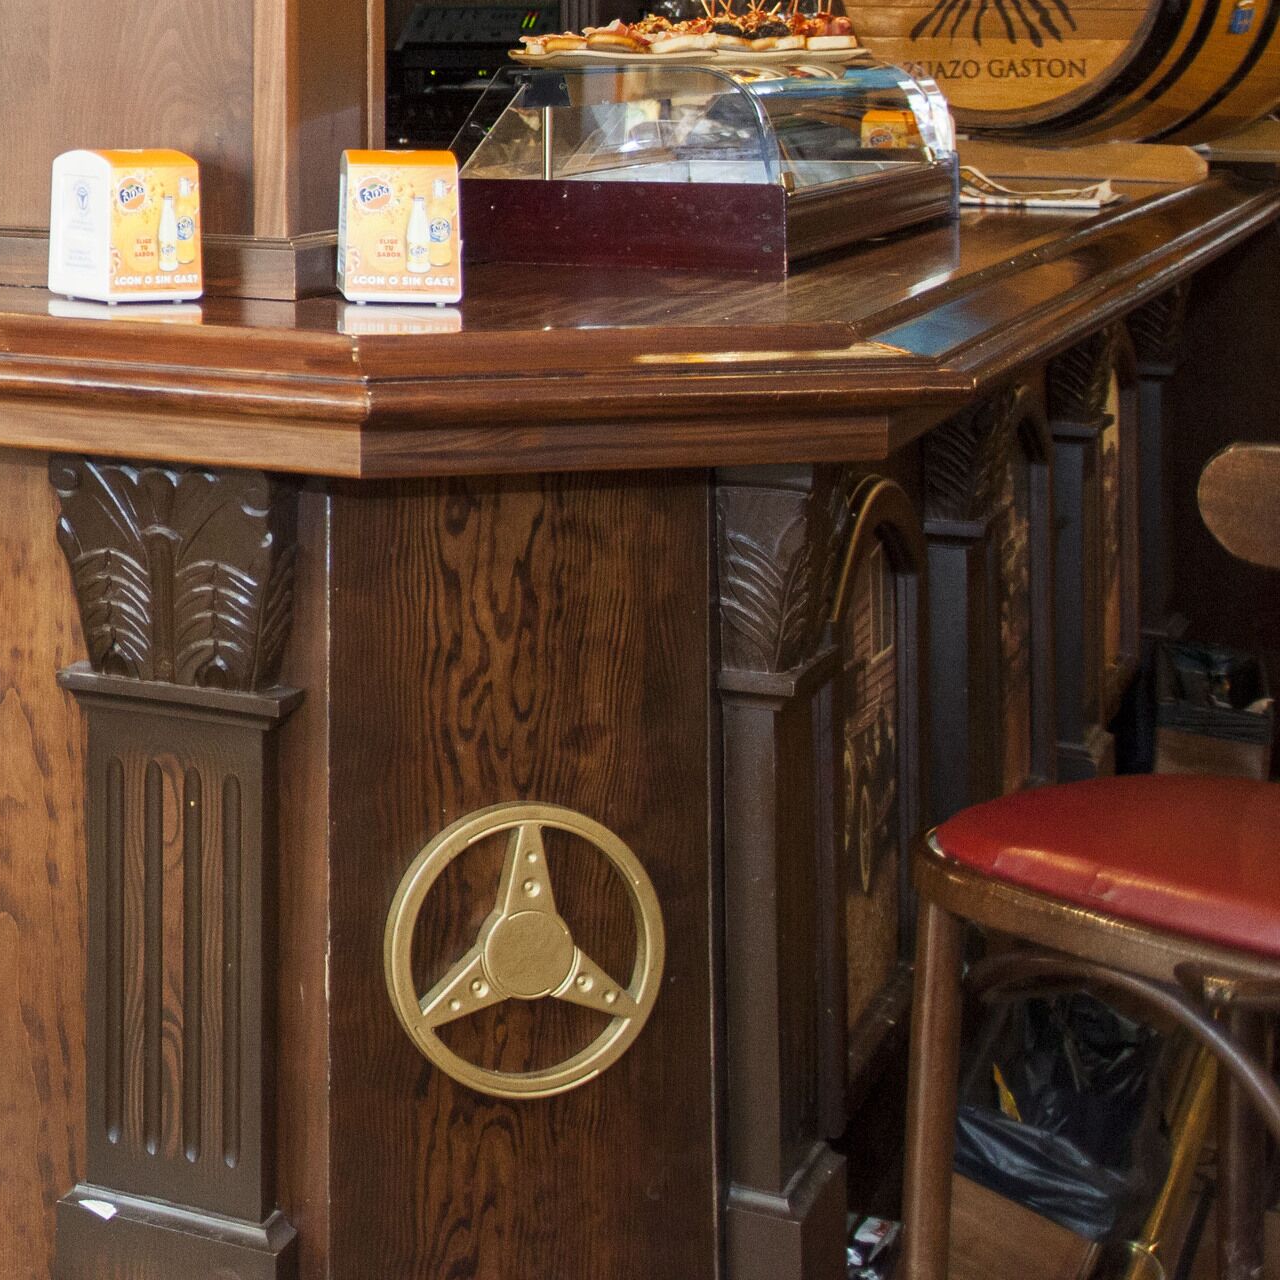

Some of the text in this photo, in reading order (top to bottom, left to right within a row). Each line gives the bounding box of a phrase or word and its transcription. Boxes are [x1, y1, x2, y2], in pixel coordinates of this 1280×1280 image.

[986, 58, 1088, 79] GASTON
[144, 276, 153, 285] O
[155, 275, 172, 285] SIN
[388, 276, 398, 285] O
[401, 276, 421, 286] SIN
